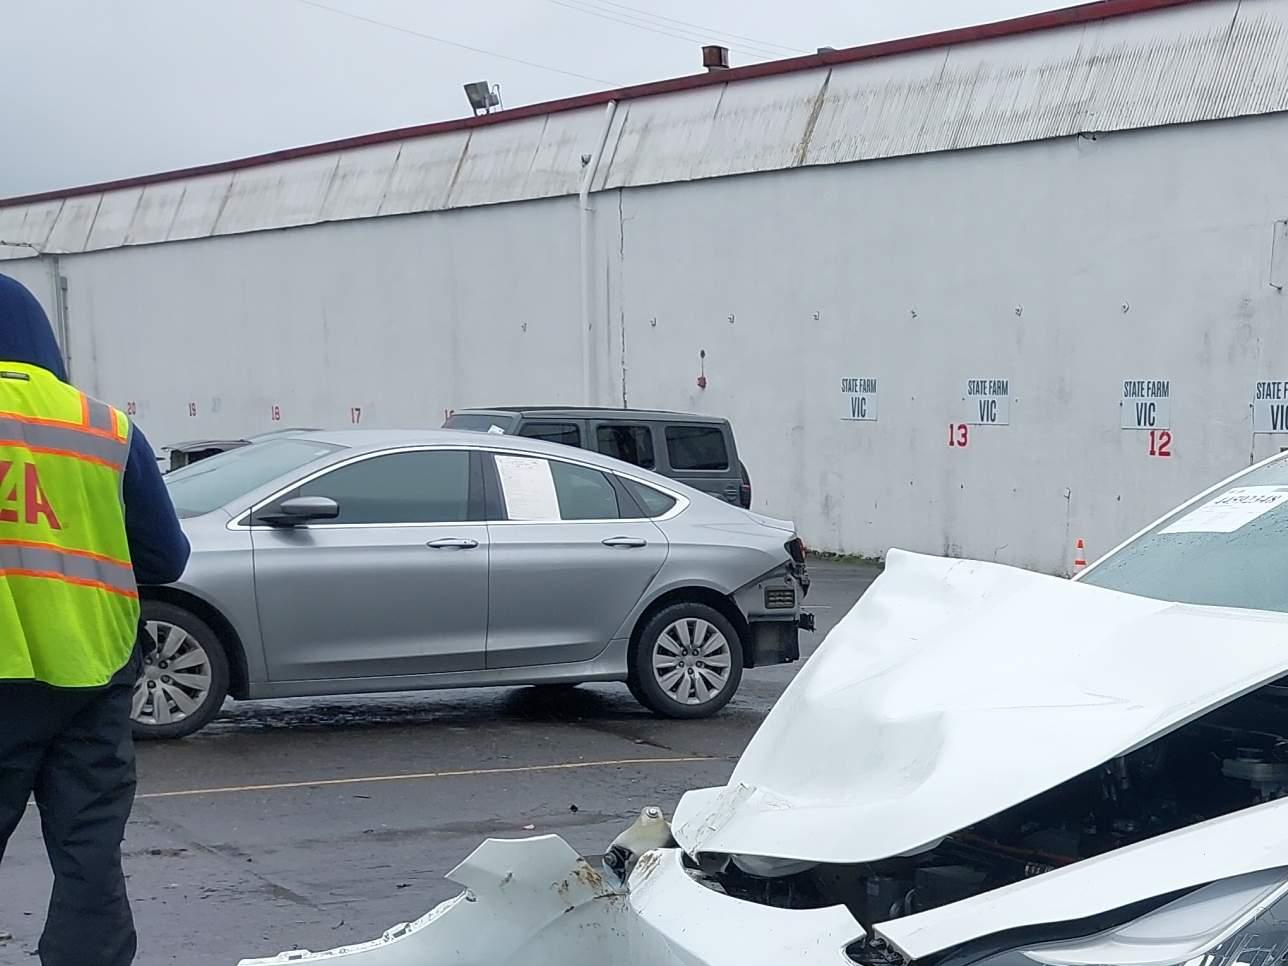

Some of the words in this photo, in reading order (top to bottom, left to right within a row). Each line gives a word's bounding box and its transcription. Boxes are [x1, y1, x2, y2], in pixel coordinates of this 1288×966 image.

[841, 378, 858, 393] STATE
[859, 378, 877, 393] FARM
[967, 380, 988, 396] STATE
[988, 380, 1009, 396] FARM
[1123, 380, 1145, 398] STATE
[1146, 380, 1170, 398] FARM
[1256, 381, 1282, 400] STATE
[271, 405, 281, 421] 18
[350, 407, 361, 424] 17
[850, 397, 867, 418] VIC
[978, 399, 997, 423] VIC
[1135, 402, 1157, 427] VIC
[948, 423, 968, 447] 13
[1149, 430, 1171, 457] 12
